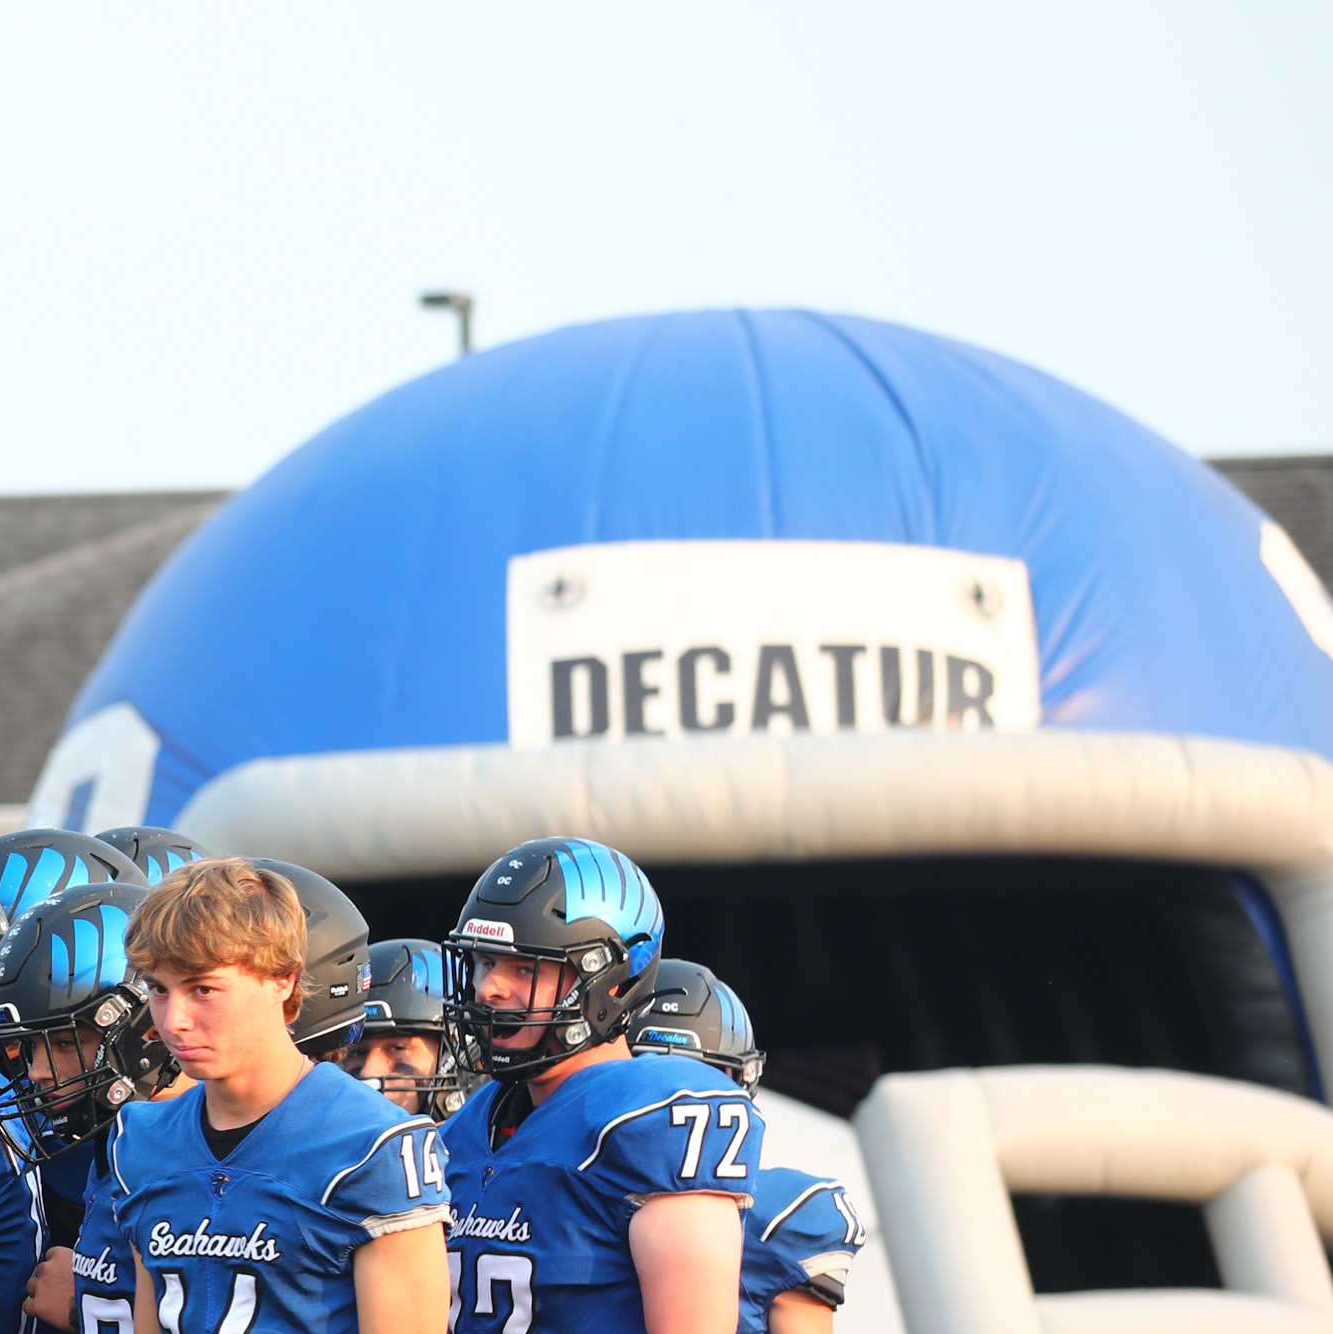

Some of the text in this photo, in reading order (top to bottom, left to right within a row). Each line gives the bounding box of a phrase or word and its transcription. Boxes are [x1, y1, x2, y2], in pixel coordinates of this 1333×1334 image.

[549, 643, 996, 738] DECATUR
[466, 921, 504, 937] Riddell
[661, 1002, 678, 1012] OC
[670, 1103, 751, 1180] 72
[148, 1218, 282, 1263] Seahawks
